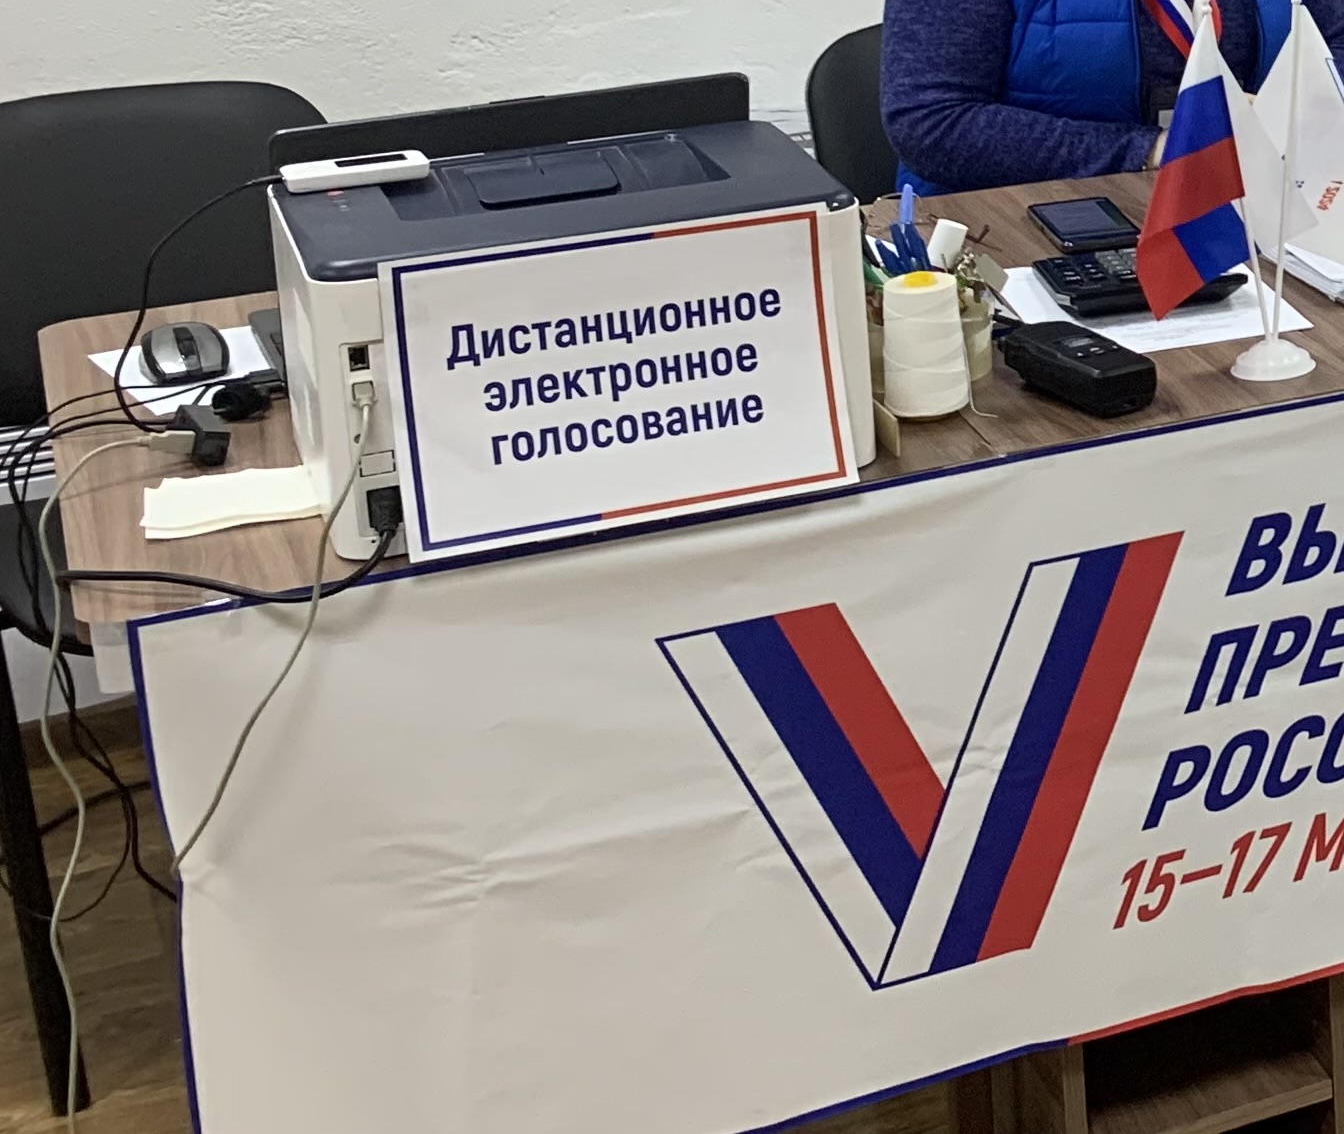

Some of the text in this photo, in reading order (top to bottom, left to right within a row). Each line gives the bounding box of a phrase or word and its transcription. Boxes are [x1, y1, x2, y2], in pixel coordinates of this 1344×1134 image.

[446, 288, 782, 370] Дистанционное
[482, 342, 759, 414] электронное
[491, 393, 765, 466] голосование
